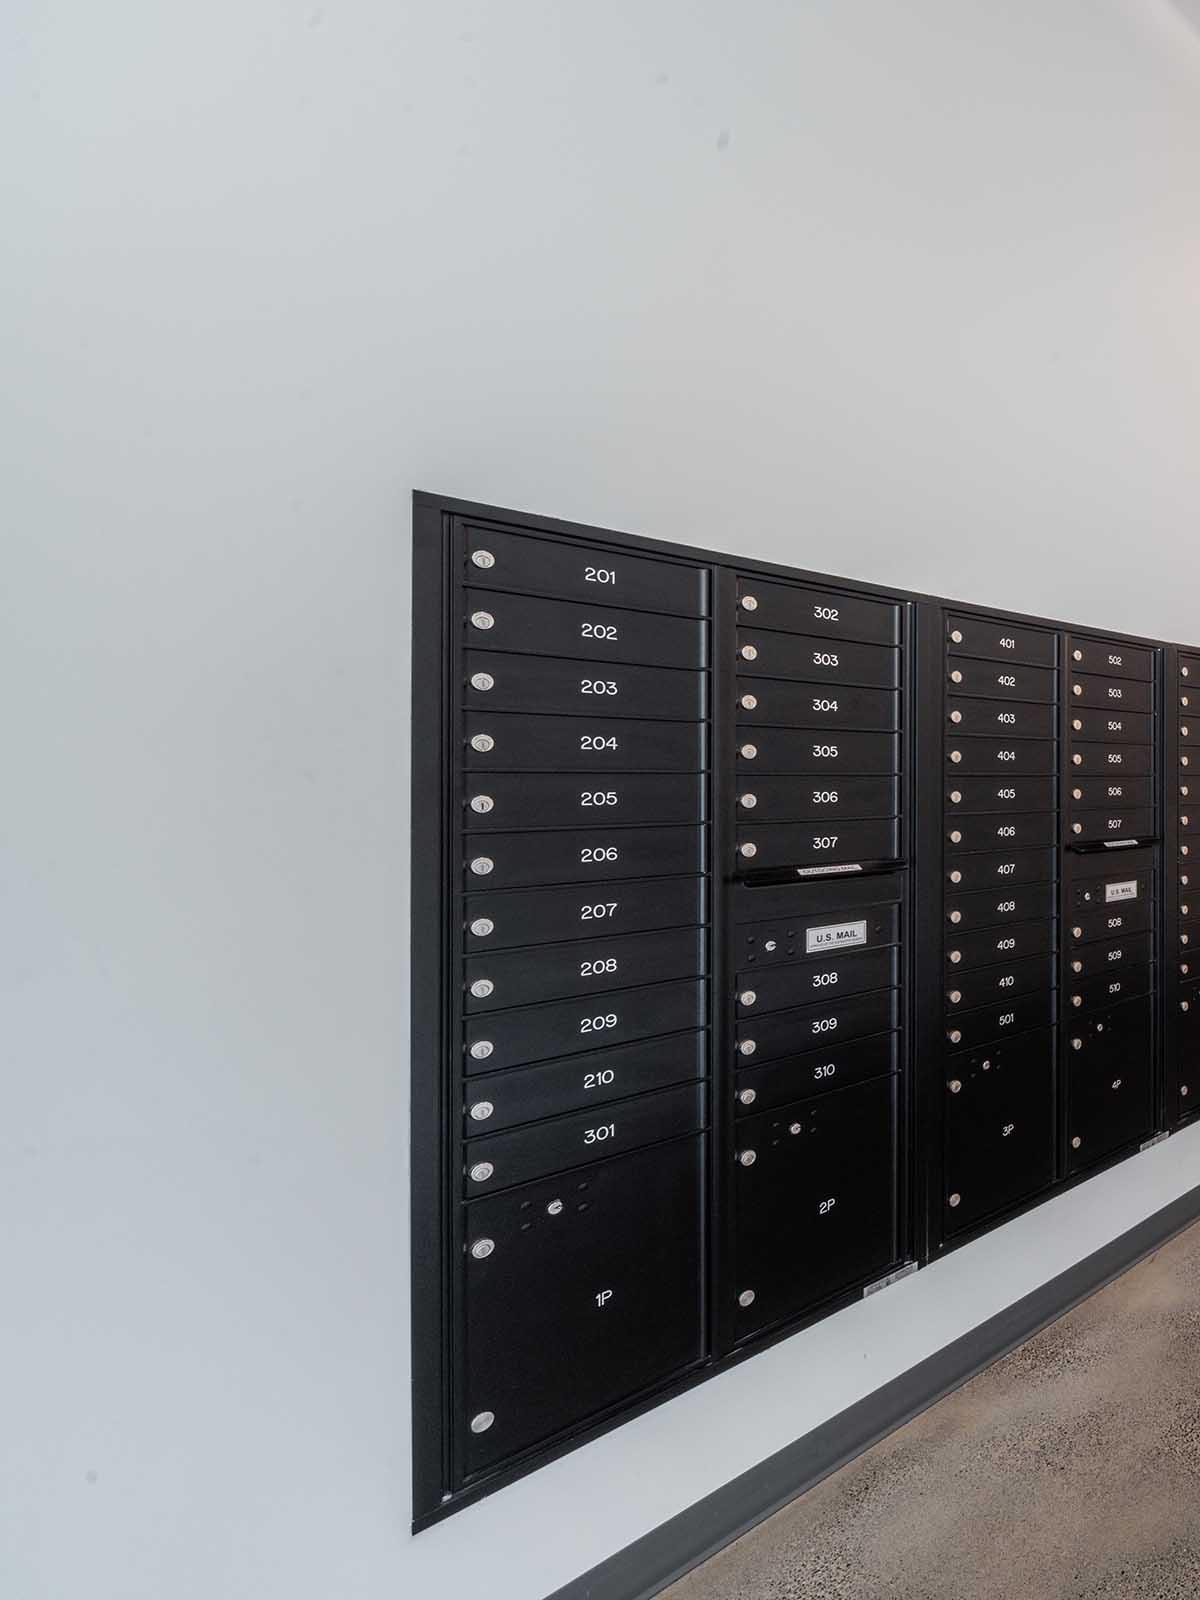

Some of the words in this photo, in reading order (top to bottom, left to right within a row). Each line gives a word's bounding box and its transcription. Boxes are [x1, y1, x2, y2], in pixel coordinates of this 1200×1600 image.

[584, 566, 616, 585] 201
[813, 605, 840, 622] 302
[580, 622, 619, 641] 202
[999, 637, 1015, 649] 401
[812, 651, 841, 667] 303
[1108, 654, 1123, 667] 502
[580, 679, 619, 696] 203
[997, 675, 1016, 687] 402
[1107, 687, 1123, 699] 503
[812, 698, 839, 712] 304
[996, 712, 1016, 725] 403
[1107, 720, 1123, 731] 504
[580, 735, 619, 751] 204
[812, 744, 839, 758] 305
[996, 750, 1016, 761] 404
[1107, 753, 1123, 764] 505
[812, 791, 839, 804] 306
[996, 788, 1016, 800] 405
[1107, 786, 1123, 797] 506
[580, 791, 619, 807] 205
[996, 824, 1017, 837] 406
[1107, 819, 1123, 829] 507
[812, 835, 839, 850] 307
[580, 846, 619, 863] 206
[996, 863, 1016, 875] 407
[580, 902, 619, 921] 207
[996, 900, 1016, 913] 408
[1107, 917, 1123, 929] 508
[816, 933, 834, 943] U.S.
[836, 929, 858, 940] MAIL
[996, 937, 1016, 951] 409
[1107, 949, 1123, 961] 509
[580, 958, 618, 977] 208
[812, 971, 839, 988] 308
[998, 975, 1015, 988] 410
[1108, 982, 1121, 994] 510
[580, 1013, 618, 1034] 209
[811, 1016, 839, 1034] 309
[998, 1012, 1015, 1026] 501
[813, 1063, 836, 1080] 310
[583, 1069, 615, 1089] 210
[1111, 1079, 1122, 1090] 4P
[583, 1123, 615, 1145] 301
[1001, 1123, 1015, 1137] 3P
[818, 1197, 836, 1215] 2P
[594, 1289, 614, 1308] 1P
